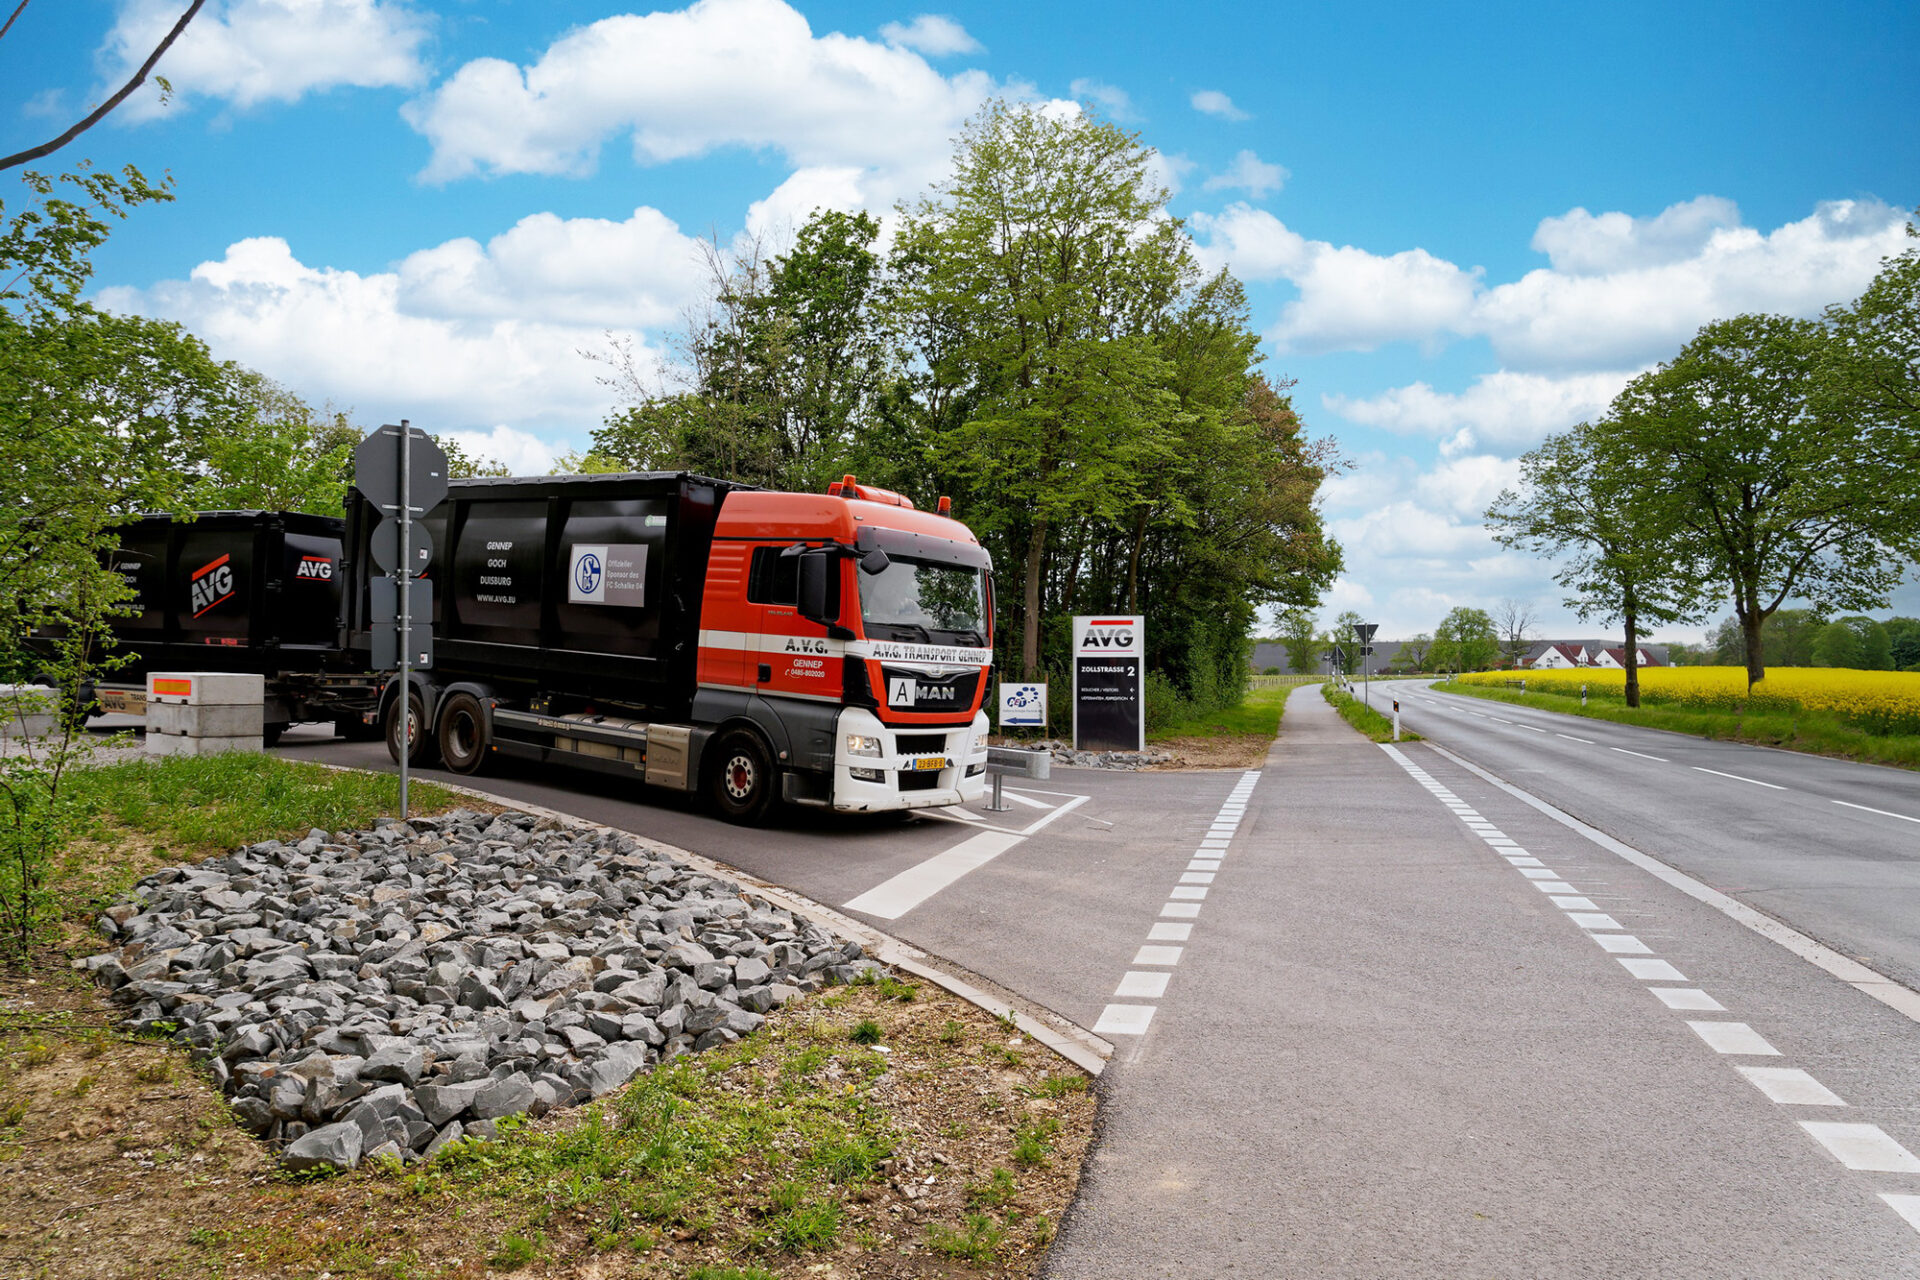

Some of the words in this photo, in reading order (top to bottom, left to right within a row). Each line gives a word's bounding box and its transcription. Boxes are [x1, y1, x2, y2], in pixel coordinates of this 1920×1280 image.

[486, 541, 513, 551] GENNEP
[487, 558, 507, 568] GOCH
[607, 559, 633, 568] Offizieller
[296, 560, 332, 579] AVG
[480, 575, 512, 587] DUISBURG
[607, 571, 629, 580] Sponsor
[629, 571, 639, 579] des
[191, 565, 234, 614] AVG
[606, 581, 613, 589] FC
[614, 581, 634, 590] Schalke
[635, 582, 643, 590] 04
[476, 593, 516, 604] WWW.AVG.EU
[1082, 629, 1134, 647] AVG
[784, 638, 828, 654] A.V.G.
[872, 644, 902, 659] A.V.G.
[903, 646, 957, 662] TRANSPORT
[958, 649, 987, 663] GENNEP
[793, 658, 823, 669] GENNEP
[1127, 666, 1135, 677] 2
[895, 681, 908, 702] A
[915, 685, 955, 700] MAN
